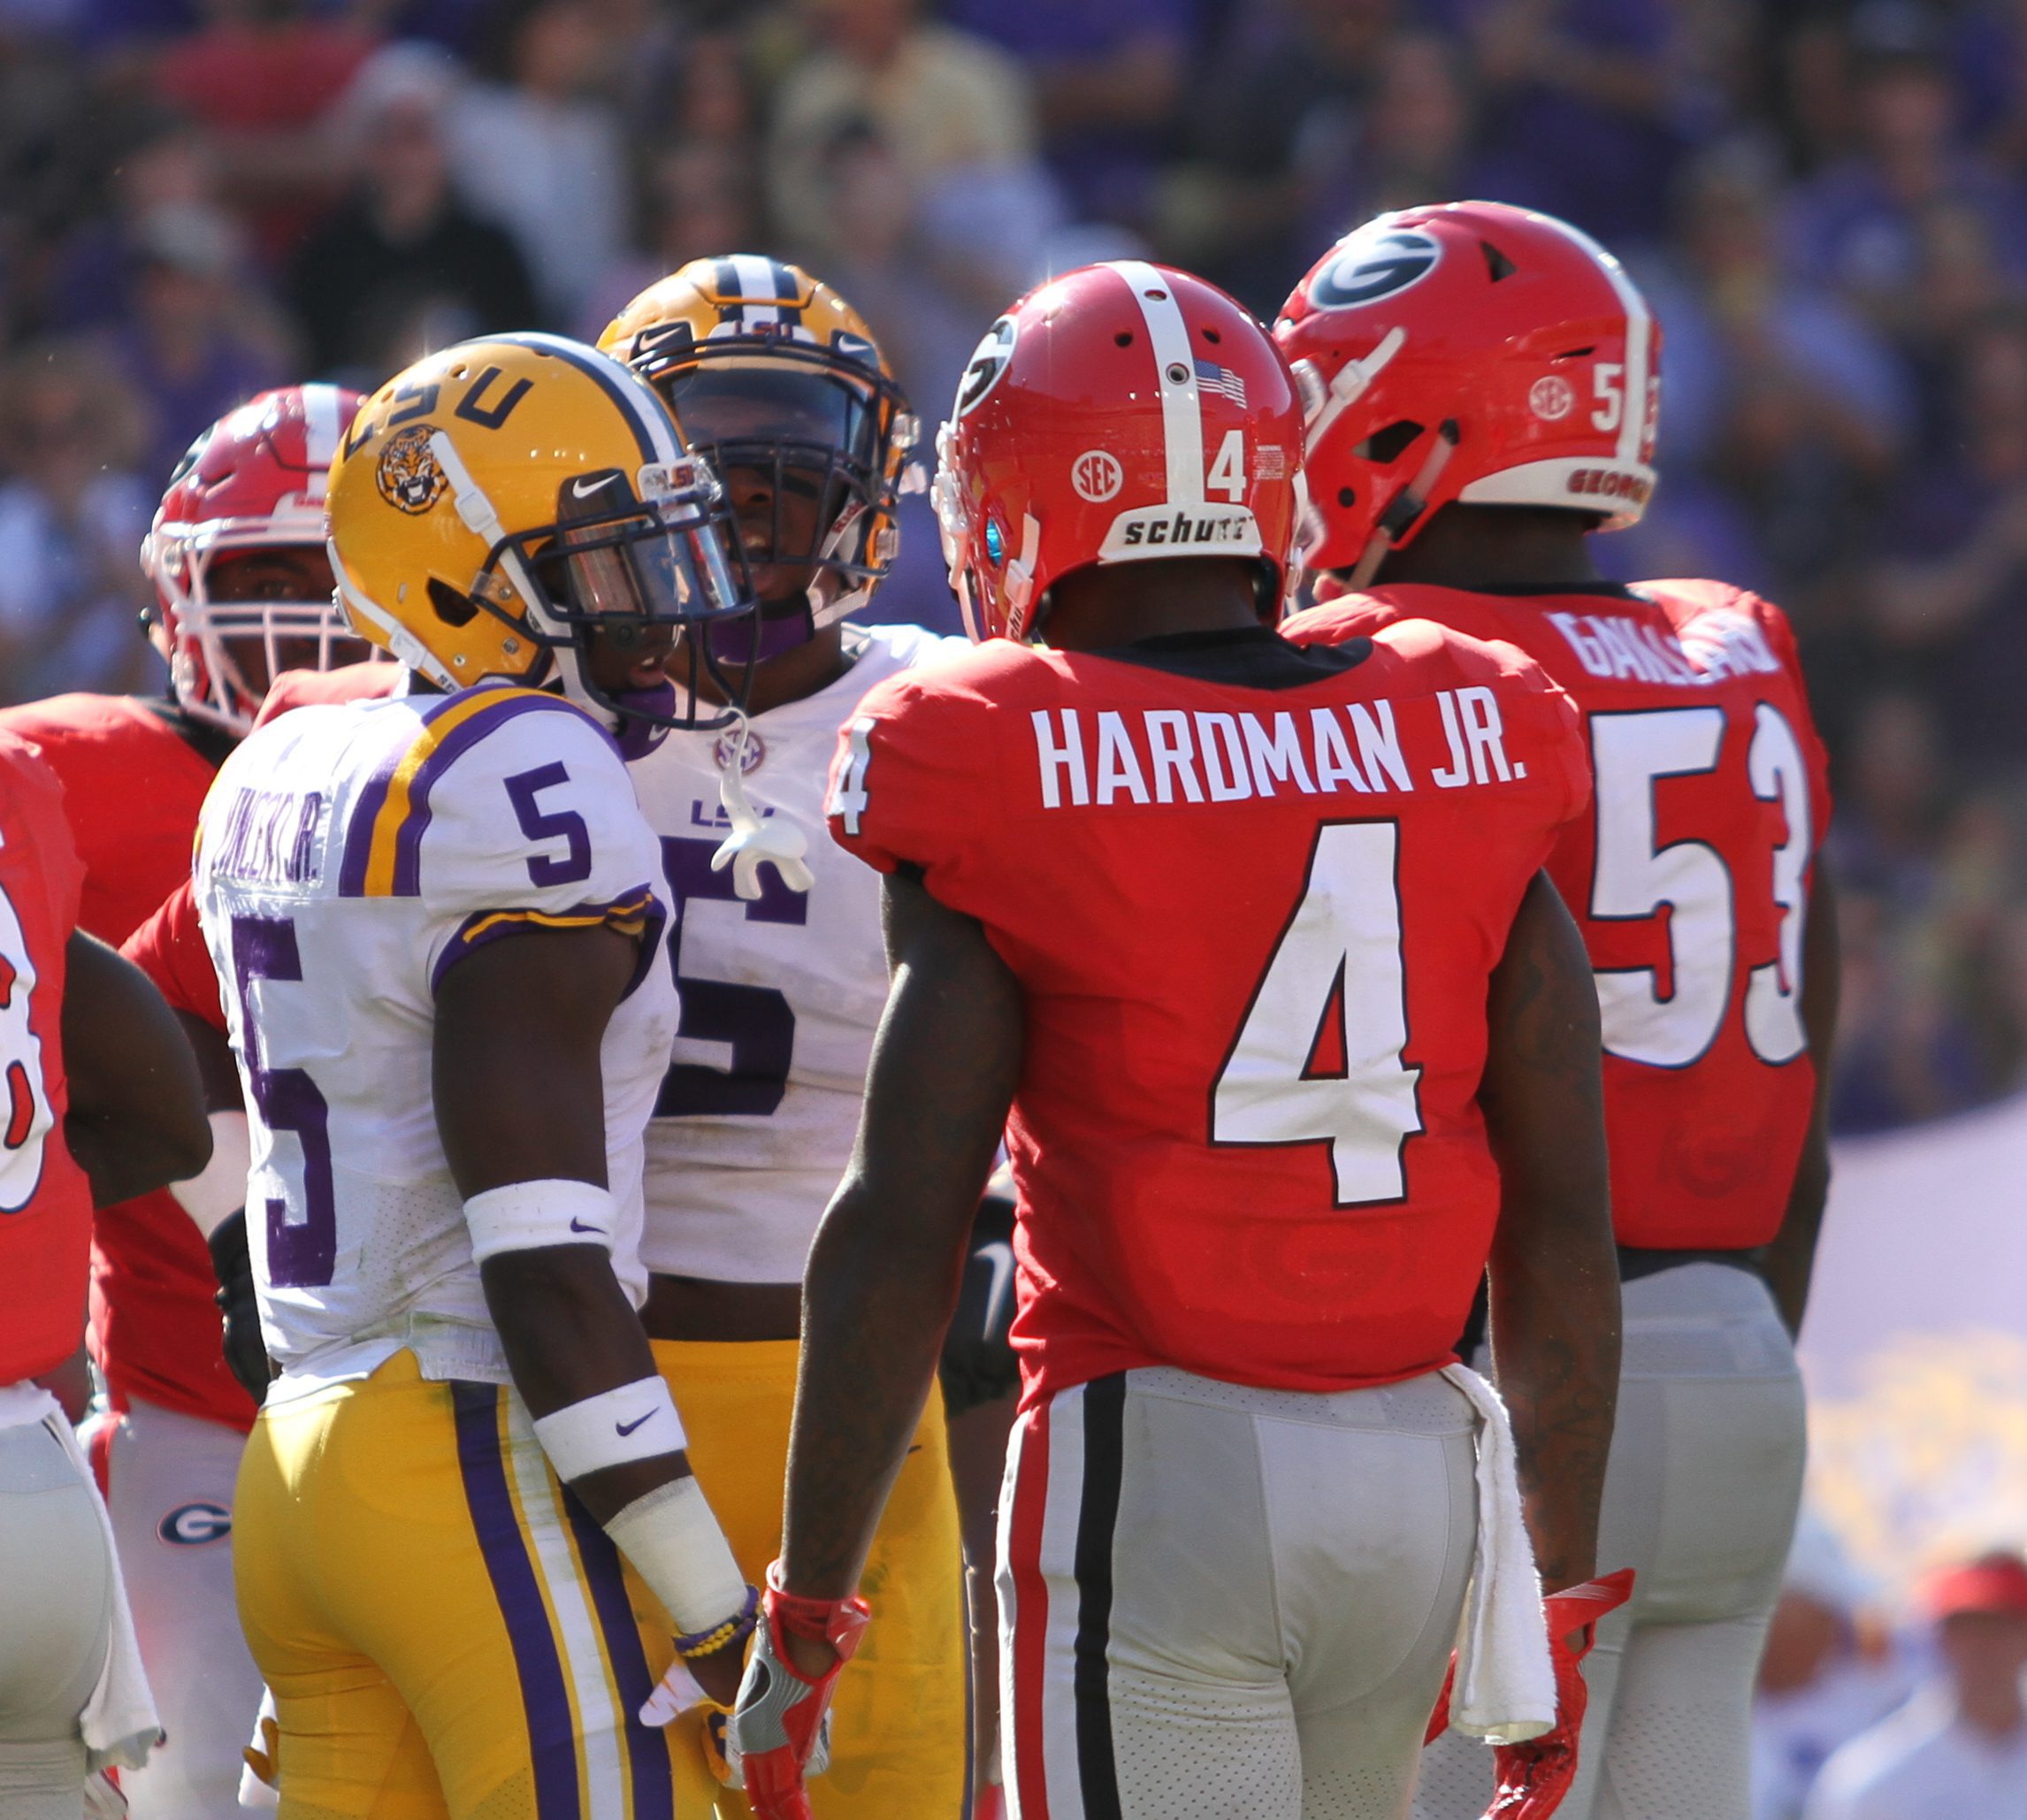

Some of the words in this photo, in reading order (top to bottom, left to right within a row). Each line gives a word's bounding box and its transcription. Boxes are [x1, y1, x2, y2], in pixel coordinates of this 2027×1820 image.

[1075, 454, 1120, 499] SEC
[1207, 430, 1247, 502] 4
[826, 715, 876, 835] 4
[1030, 699, 1415, 809] HARDMAN
[1431, 685, 1528, 789] JR.
[502, 760, 592, 889] 5
[1588, 700, 1812, 1070] 53
[1206, 815, 1427, 1212] 4
[232, 913, 337, 1289] 5
[159, 1502, 232, 1547] G
